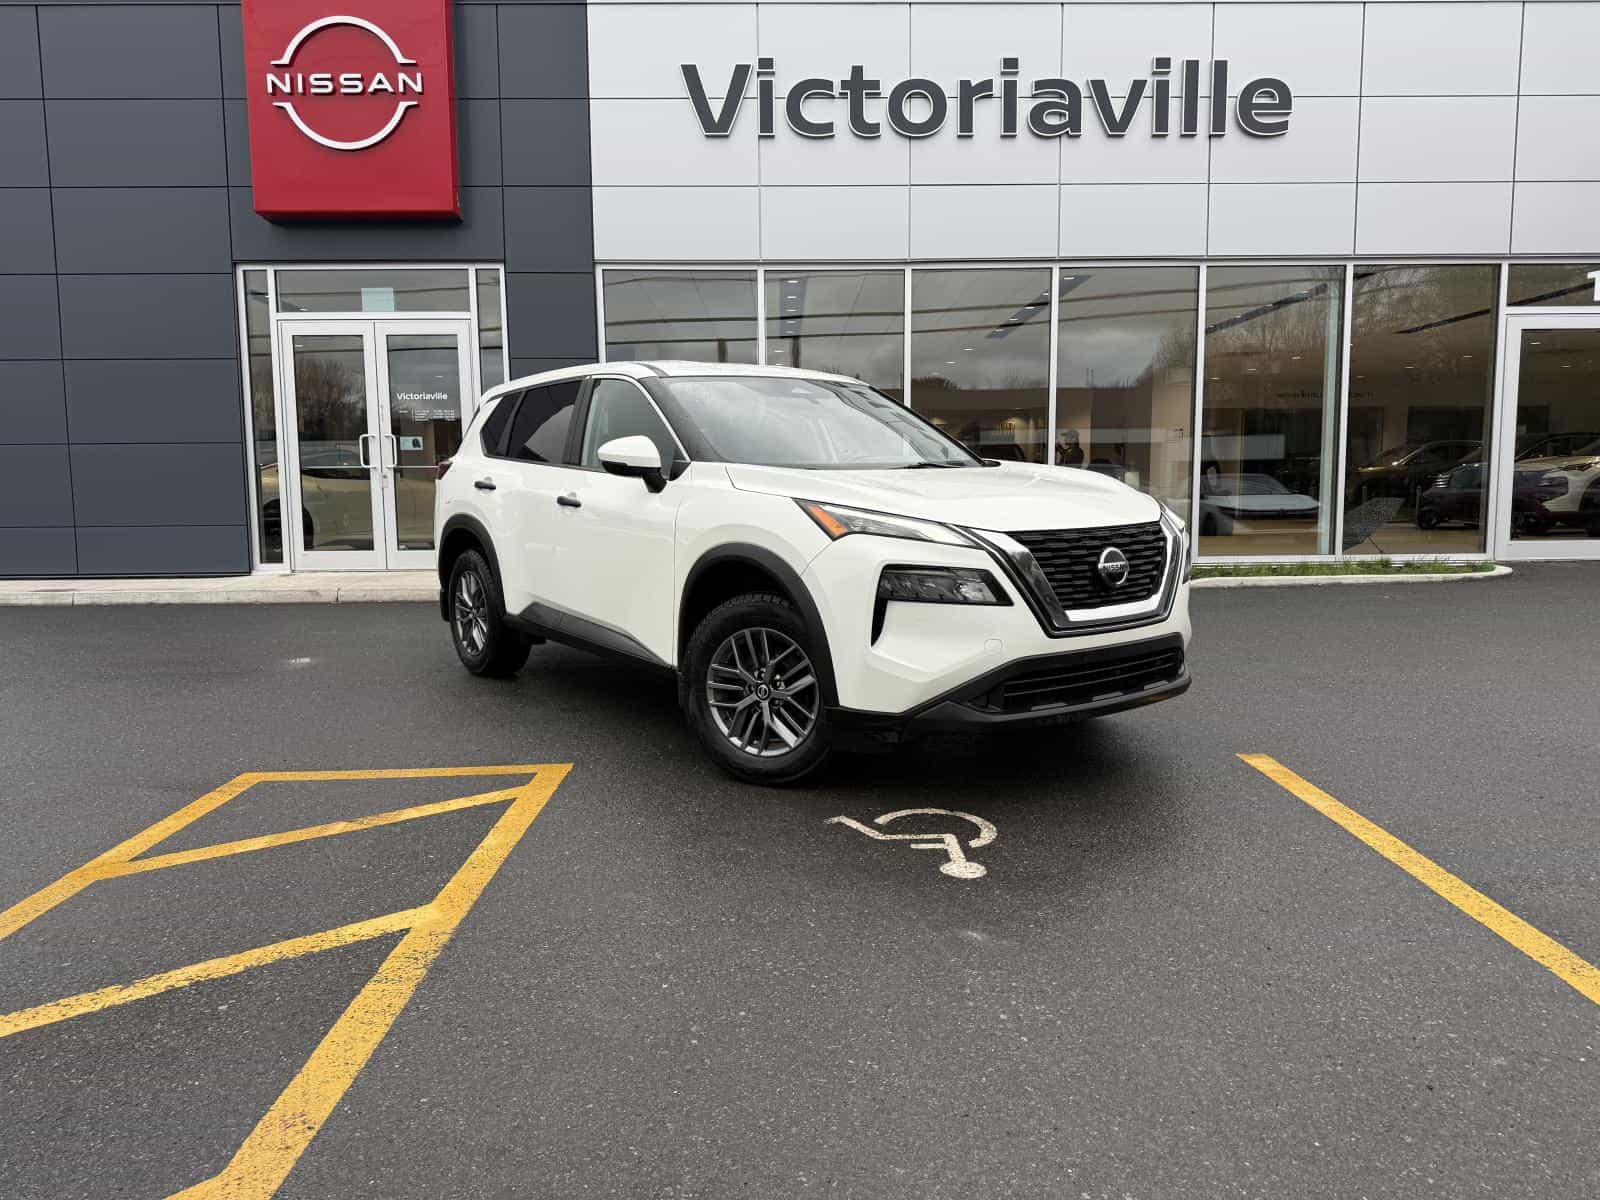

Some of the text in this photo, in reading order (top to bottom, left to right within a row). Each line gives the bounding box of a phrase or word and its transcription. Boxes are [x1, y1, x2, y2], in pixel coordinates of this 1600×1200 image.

[265, 72, 424, 95] NISSAN
[681, 57, 1293, 138] Victoriaville
[396, 391, 448, 401] Victoriaville
